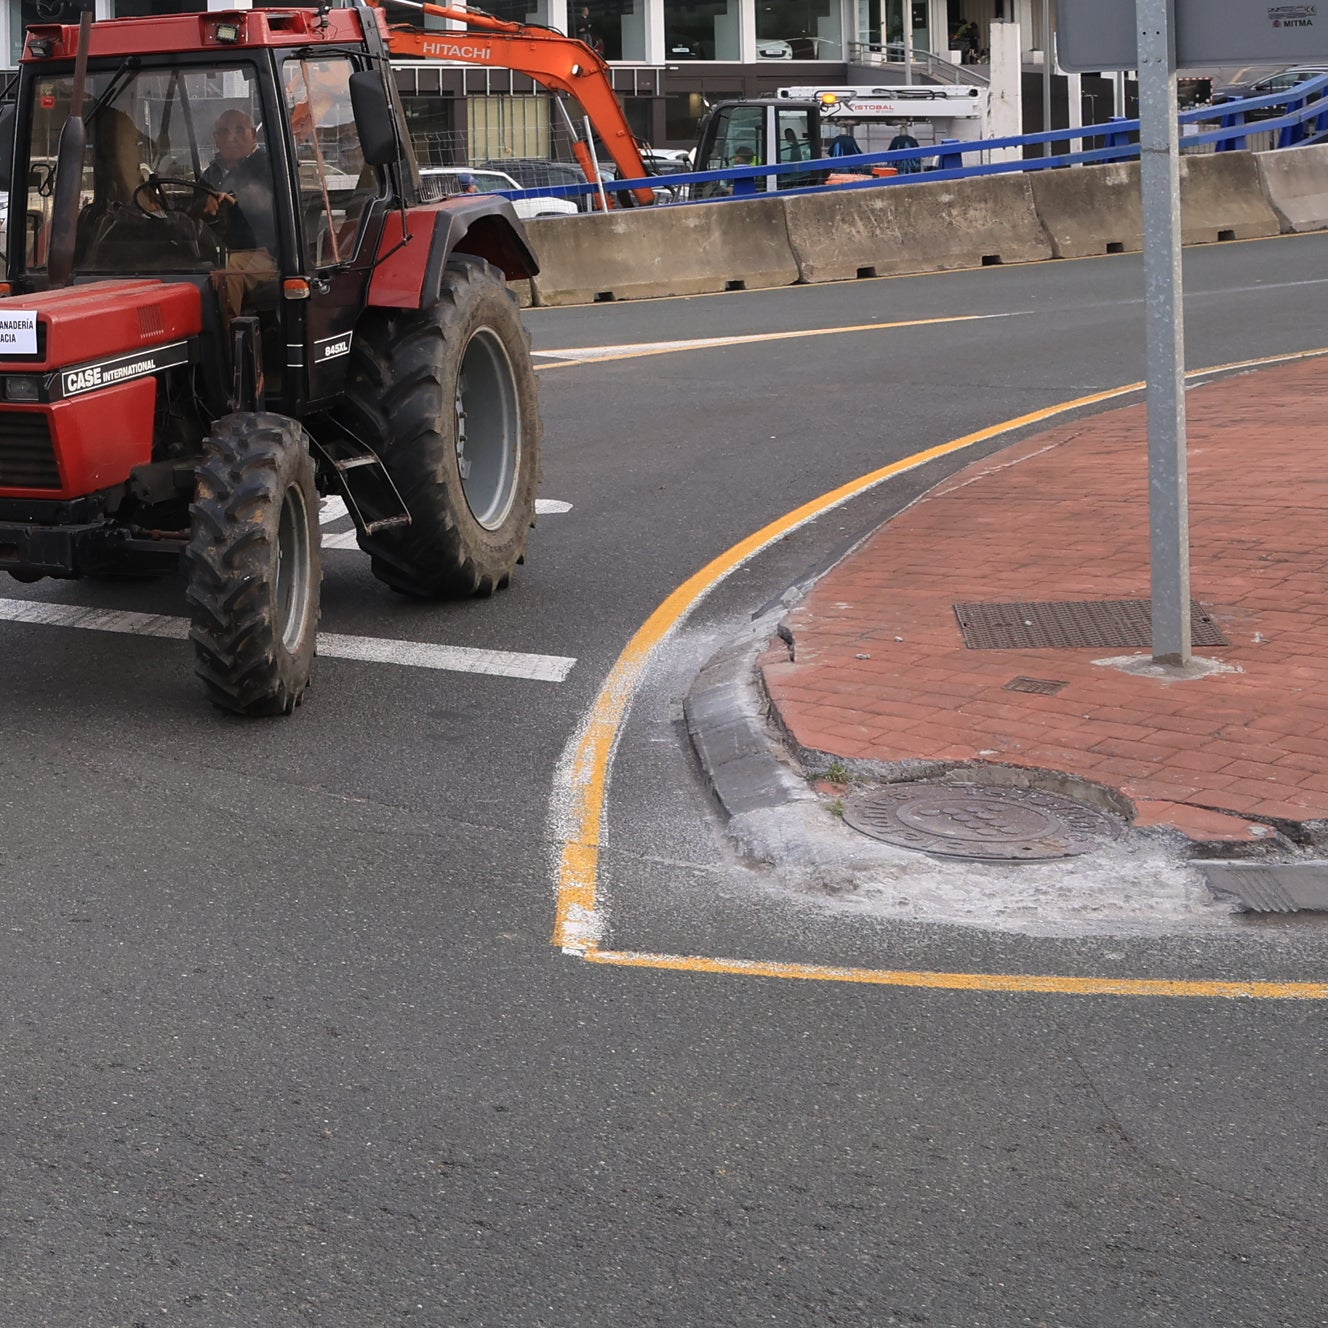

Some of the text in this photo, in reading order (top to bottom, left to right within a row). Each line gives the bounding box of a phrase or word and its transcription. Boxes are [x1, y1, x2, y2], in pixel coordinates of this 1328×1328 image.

[1283, 19, 1313, 28] MITMA
[423, 42, 490, 60] HITACHI
[325, 342, 348, 356] 845XL
[67, 359, 156, 392] CASE INTERNATIONAL
